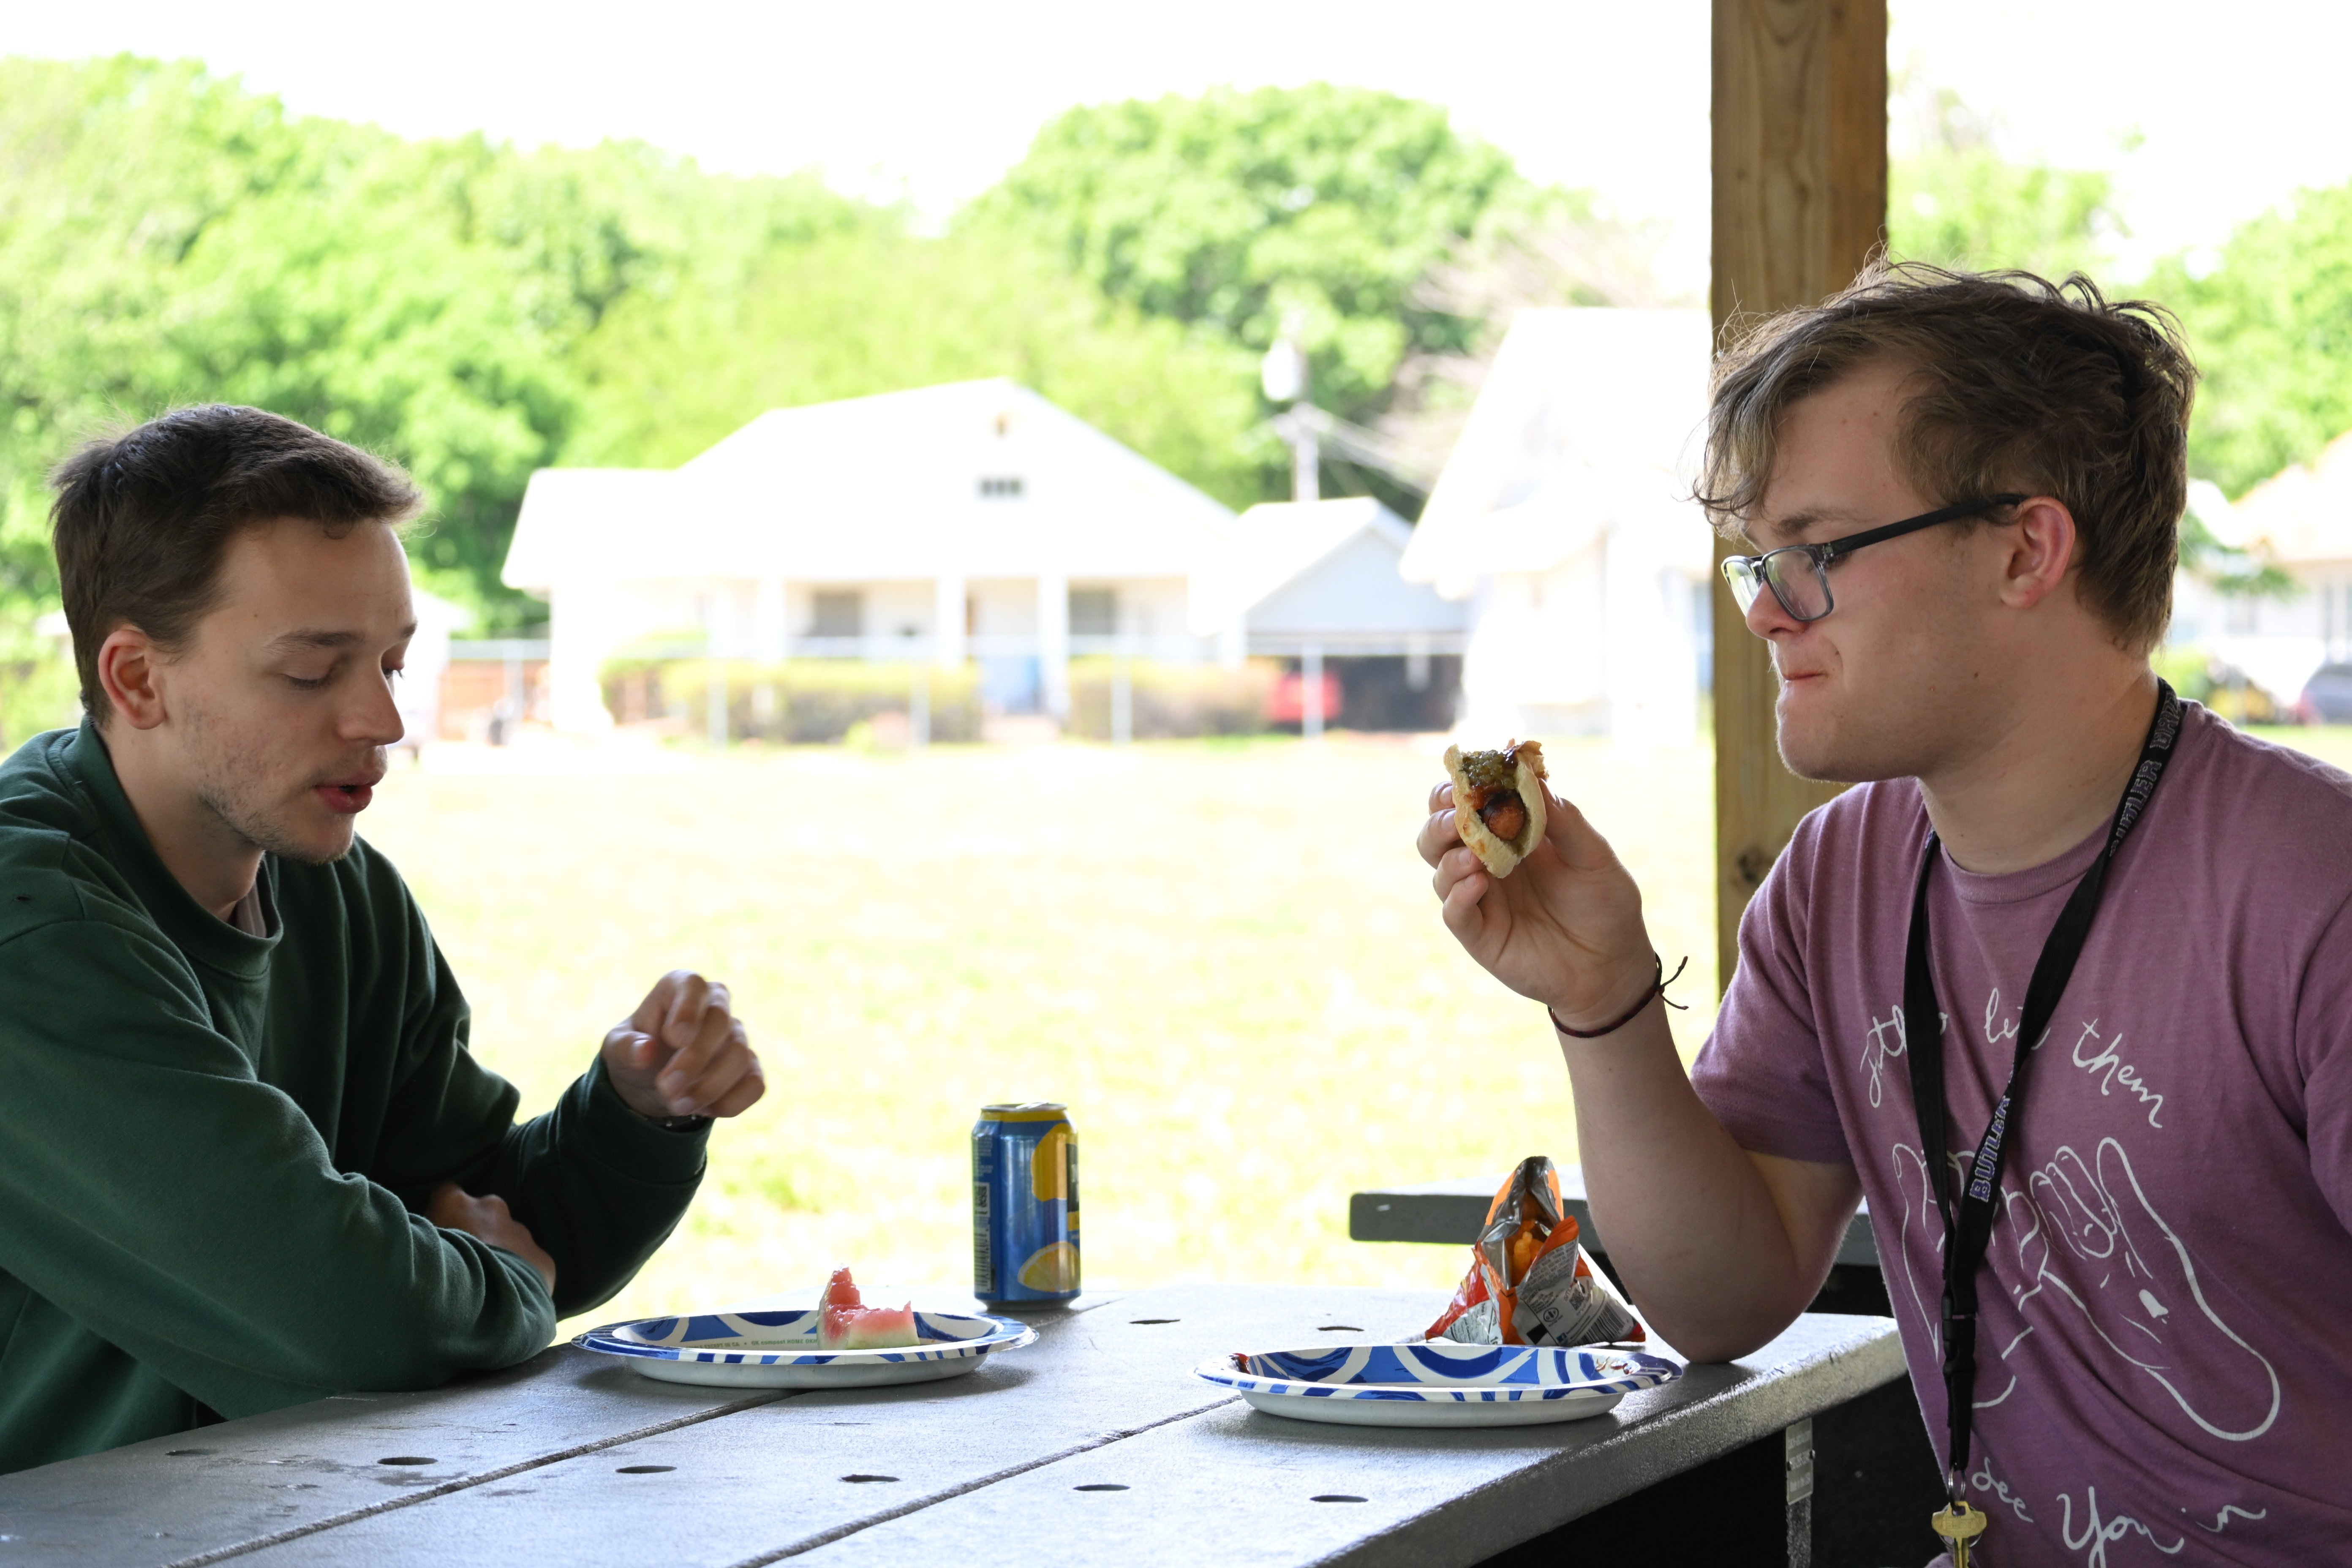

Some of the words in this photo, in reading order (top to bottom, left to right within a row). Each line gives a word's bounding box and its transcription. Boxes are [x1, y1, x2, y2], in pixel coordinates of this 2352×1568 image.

[1984, 987, 2051, 1051] le
[2072, 1018, 2163, 1128] them
[1969, 1095, 2010, 1203] BUTLER
[2056, 1486, 2184, 1568] You
